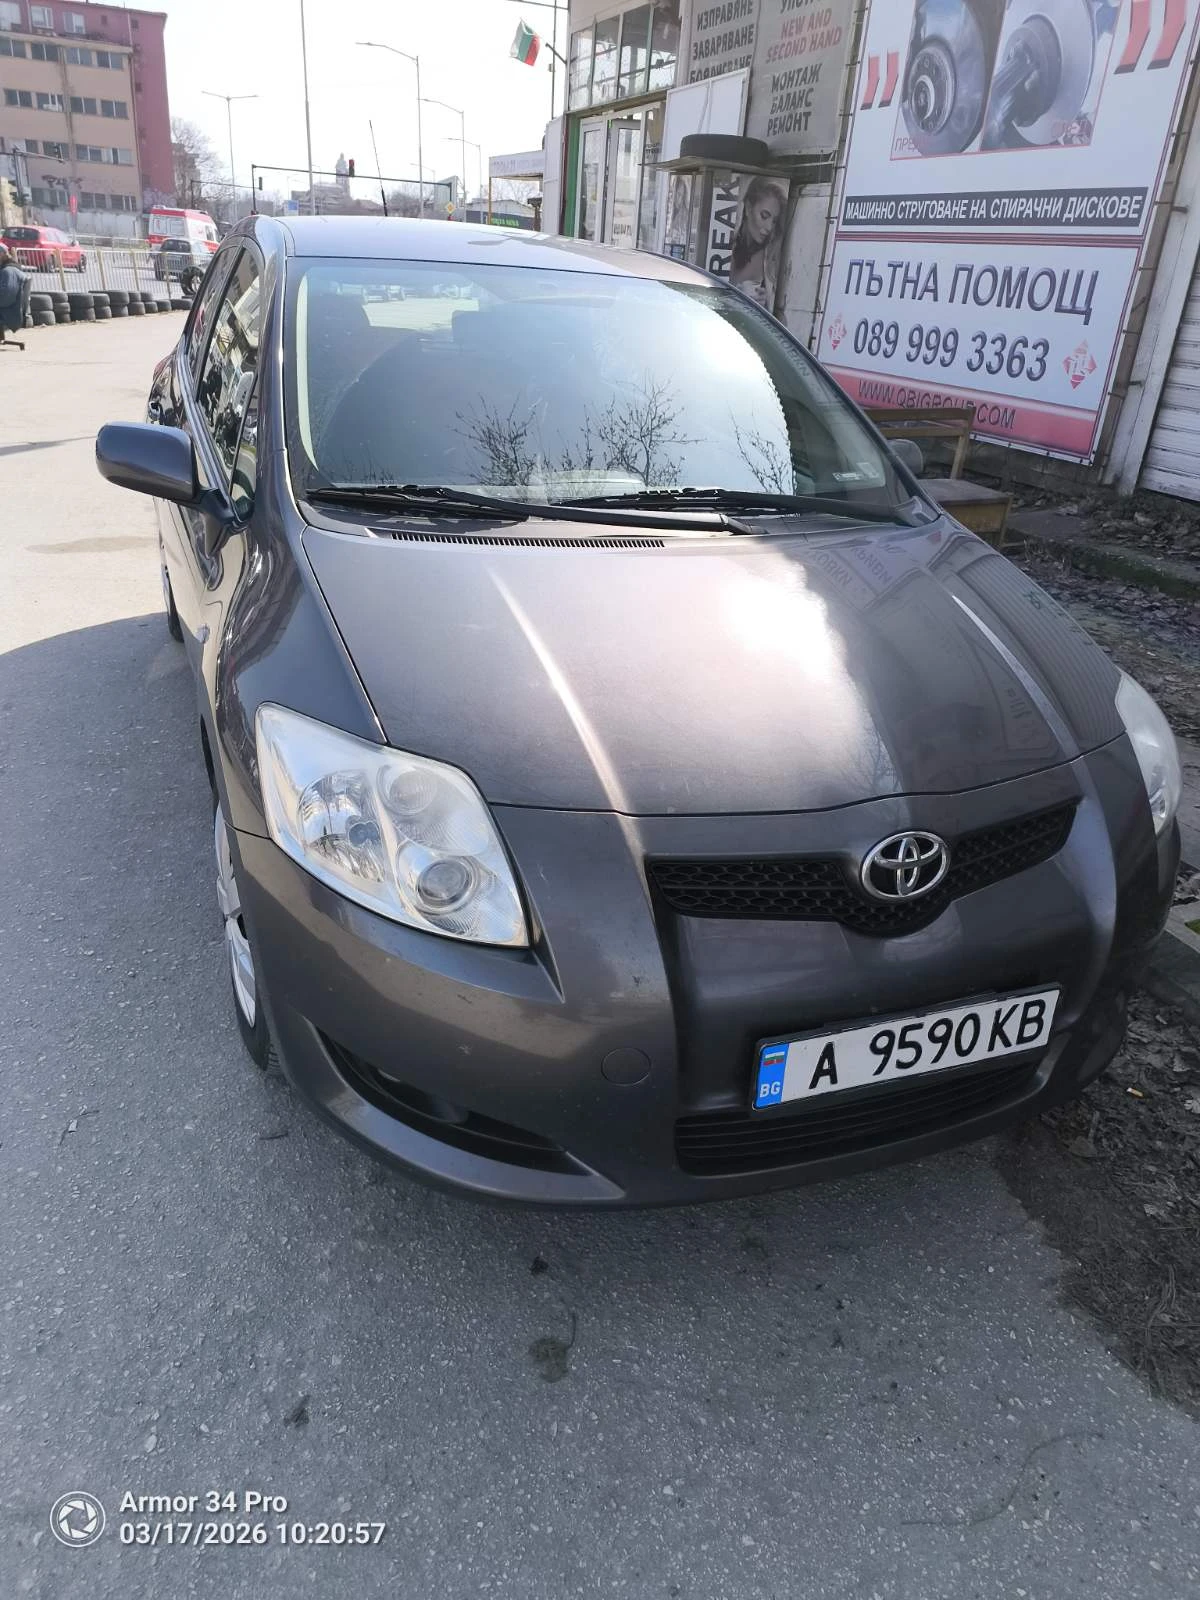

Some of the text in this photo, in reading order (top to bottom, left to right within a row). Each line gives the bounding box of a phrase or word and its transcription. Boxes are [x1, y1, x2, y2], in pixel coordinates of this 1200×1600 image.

[697, 0, 754, 31] ИЗПРАВЯНЕ
[781, 8, 832, 41] NEW AND
[693, 24, 755, 61] ЗАВАРЯВАНЕ
[766, 26, 843, 64] SECOND HAND
[772, 63, 823, 94] МОНТАЖ
[770, 88, 814, 115] БАЛАНС
[767, 111, 812, 137] РЕМОНТ
[845, 195, 1143, 223] МАШИННО СТРУГОВАНЕ НА СПИРАЧНИ ДИСКОВЕ
[844, 258, 1100, 326] ПЪТНА ПОМОЩ
[853, 317, 900, 359] 089
[906, 322, 960, 368] 999
[966, 330, 1050, 382] 3363
[869, 1012, 981, 1077] 9590
[759, 1081, 781, 1098] BG
